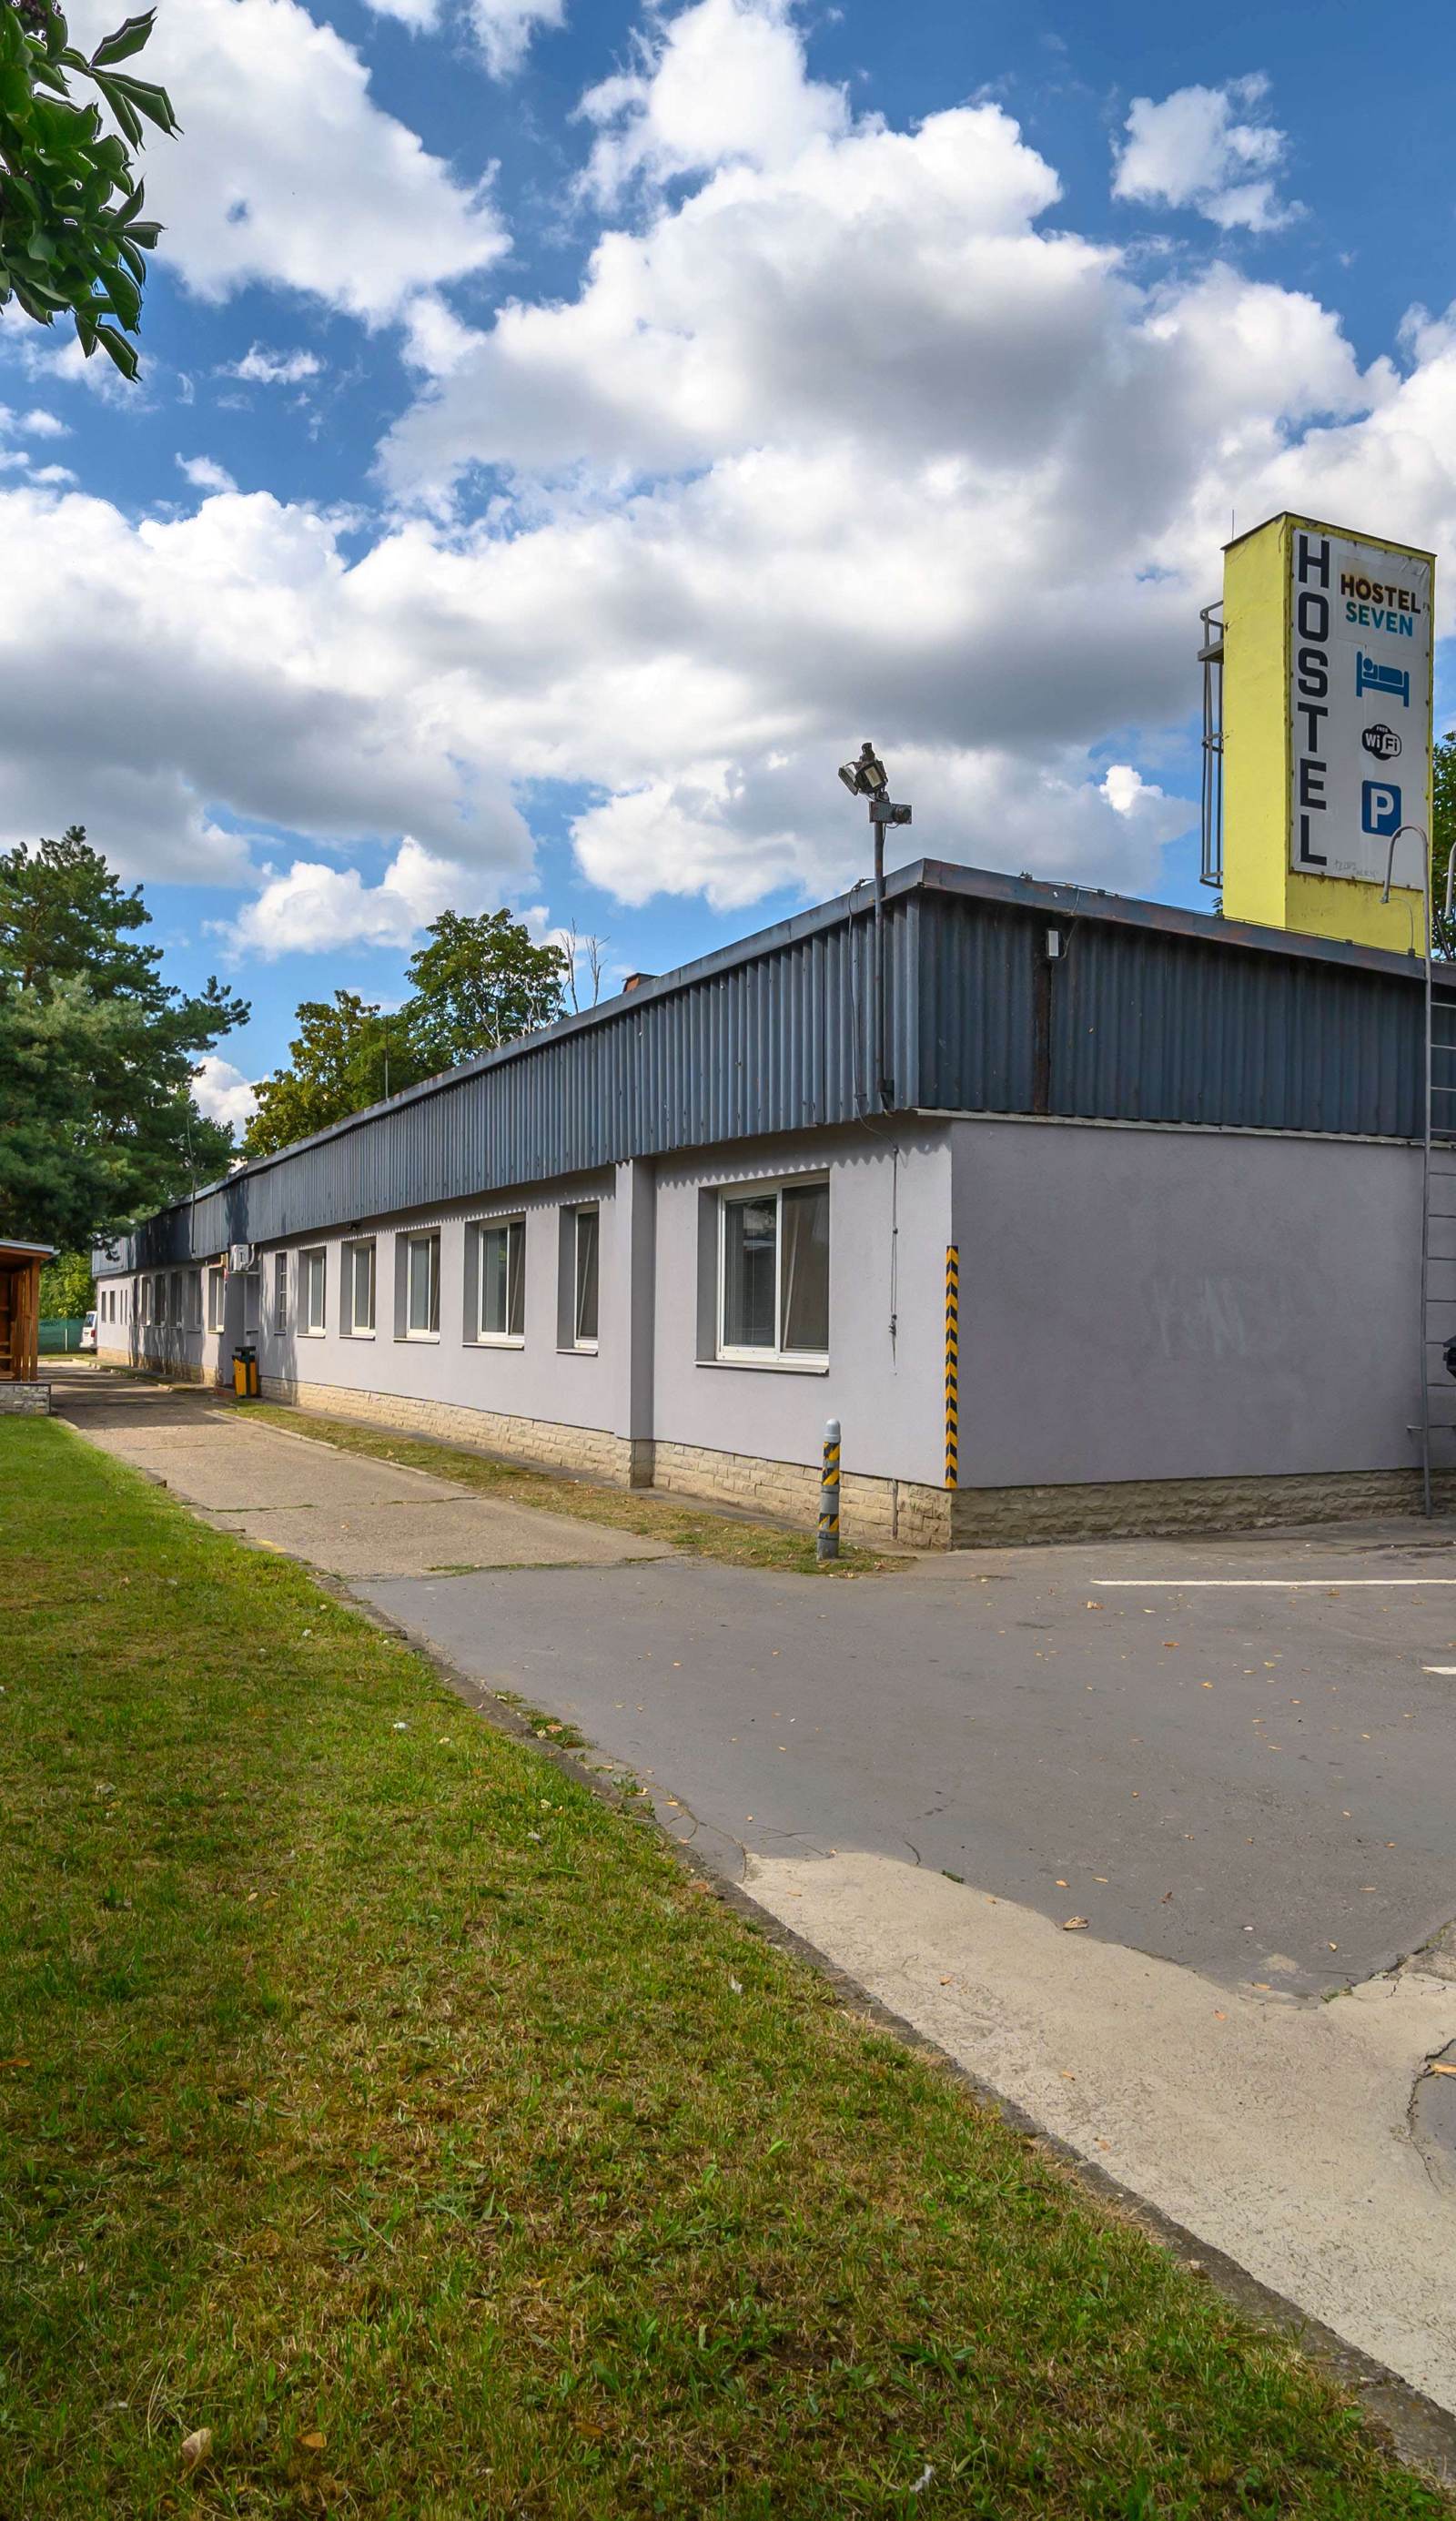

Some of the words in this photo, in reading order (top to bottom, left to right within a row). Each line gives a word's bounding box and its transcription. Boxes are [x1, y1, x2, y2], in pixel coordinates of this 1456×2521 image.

[1340, 573, 1421, 614] HOSTEL
[1345, 601, 1412, 637] SEVEN
[1298, 534, 1330, 866] HOSTEL
[1370, 788, 1395, 828] P
